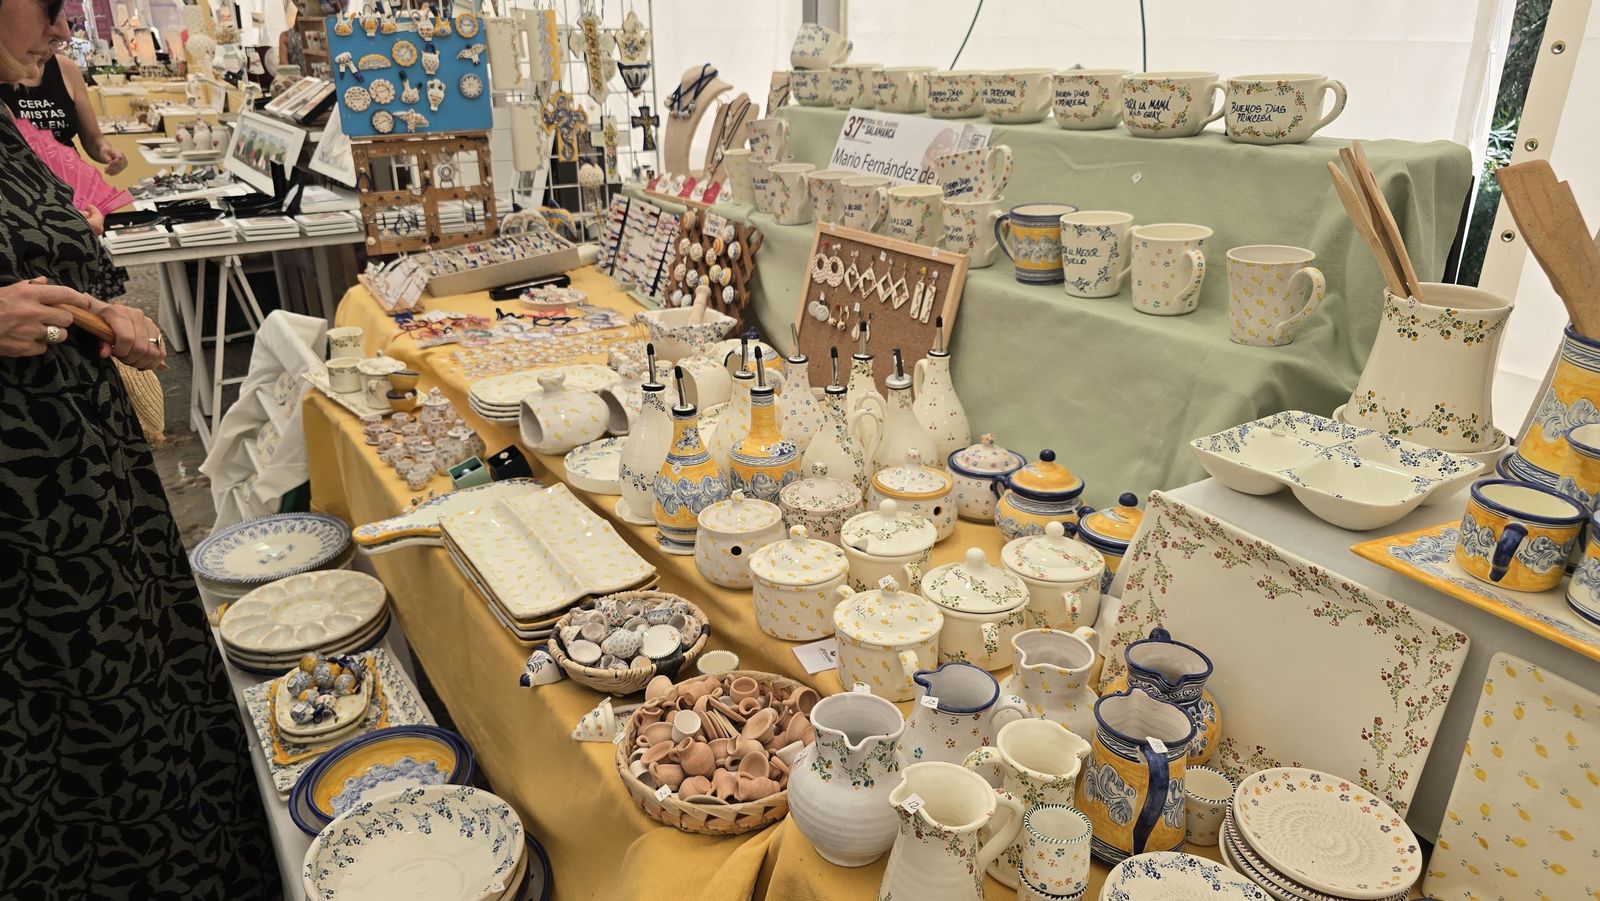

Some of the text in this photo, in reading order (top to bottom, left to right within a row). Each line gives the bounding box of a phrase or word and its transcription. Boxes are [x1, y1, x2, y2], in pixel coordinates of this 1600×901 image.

[18, 99, 55, 109] CERA-
[1138, 102, 1146, 110] LA
[1230, 101, 1262, 114] BUENOS
[20, 109, 66, 119] MISTAS
[1143, 110, 1164, 123] GUAY
[1236, 113, 1273, 123] PRINCESA
[31, 120, 70, 129] ALEN-
[844, 115, 865, 139] 37
[865, 124, 896, 139] SALAMANCA
[832, 148, 861, 169] Mario
[861, 153, 919, 182] Fernández
[918, 166, 935, 185] de
[1076, 247, 1101, 257] MEJOR
